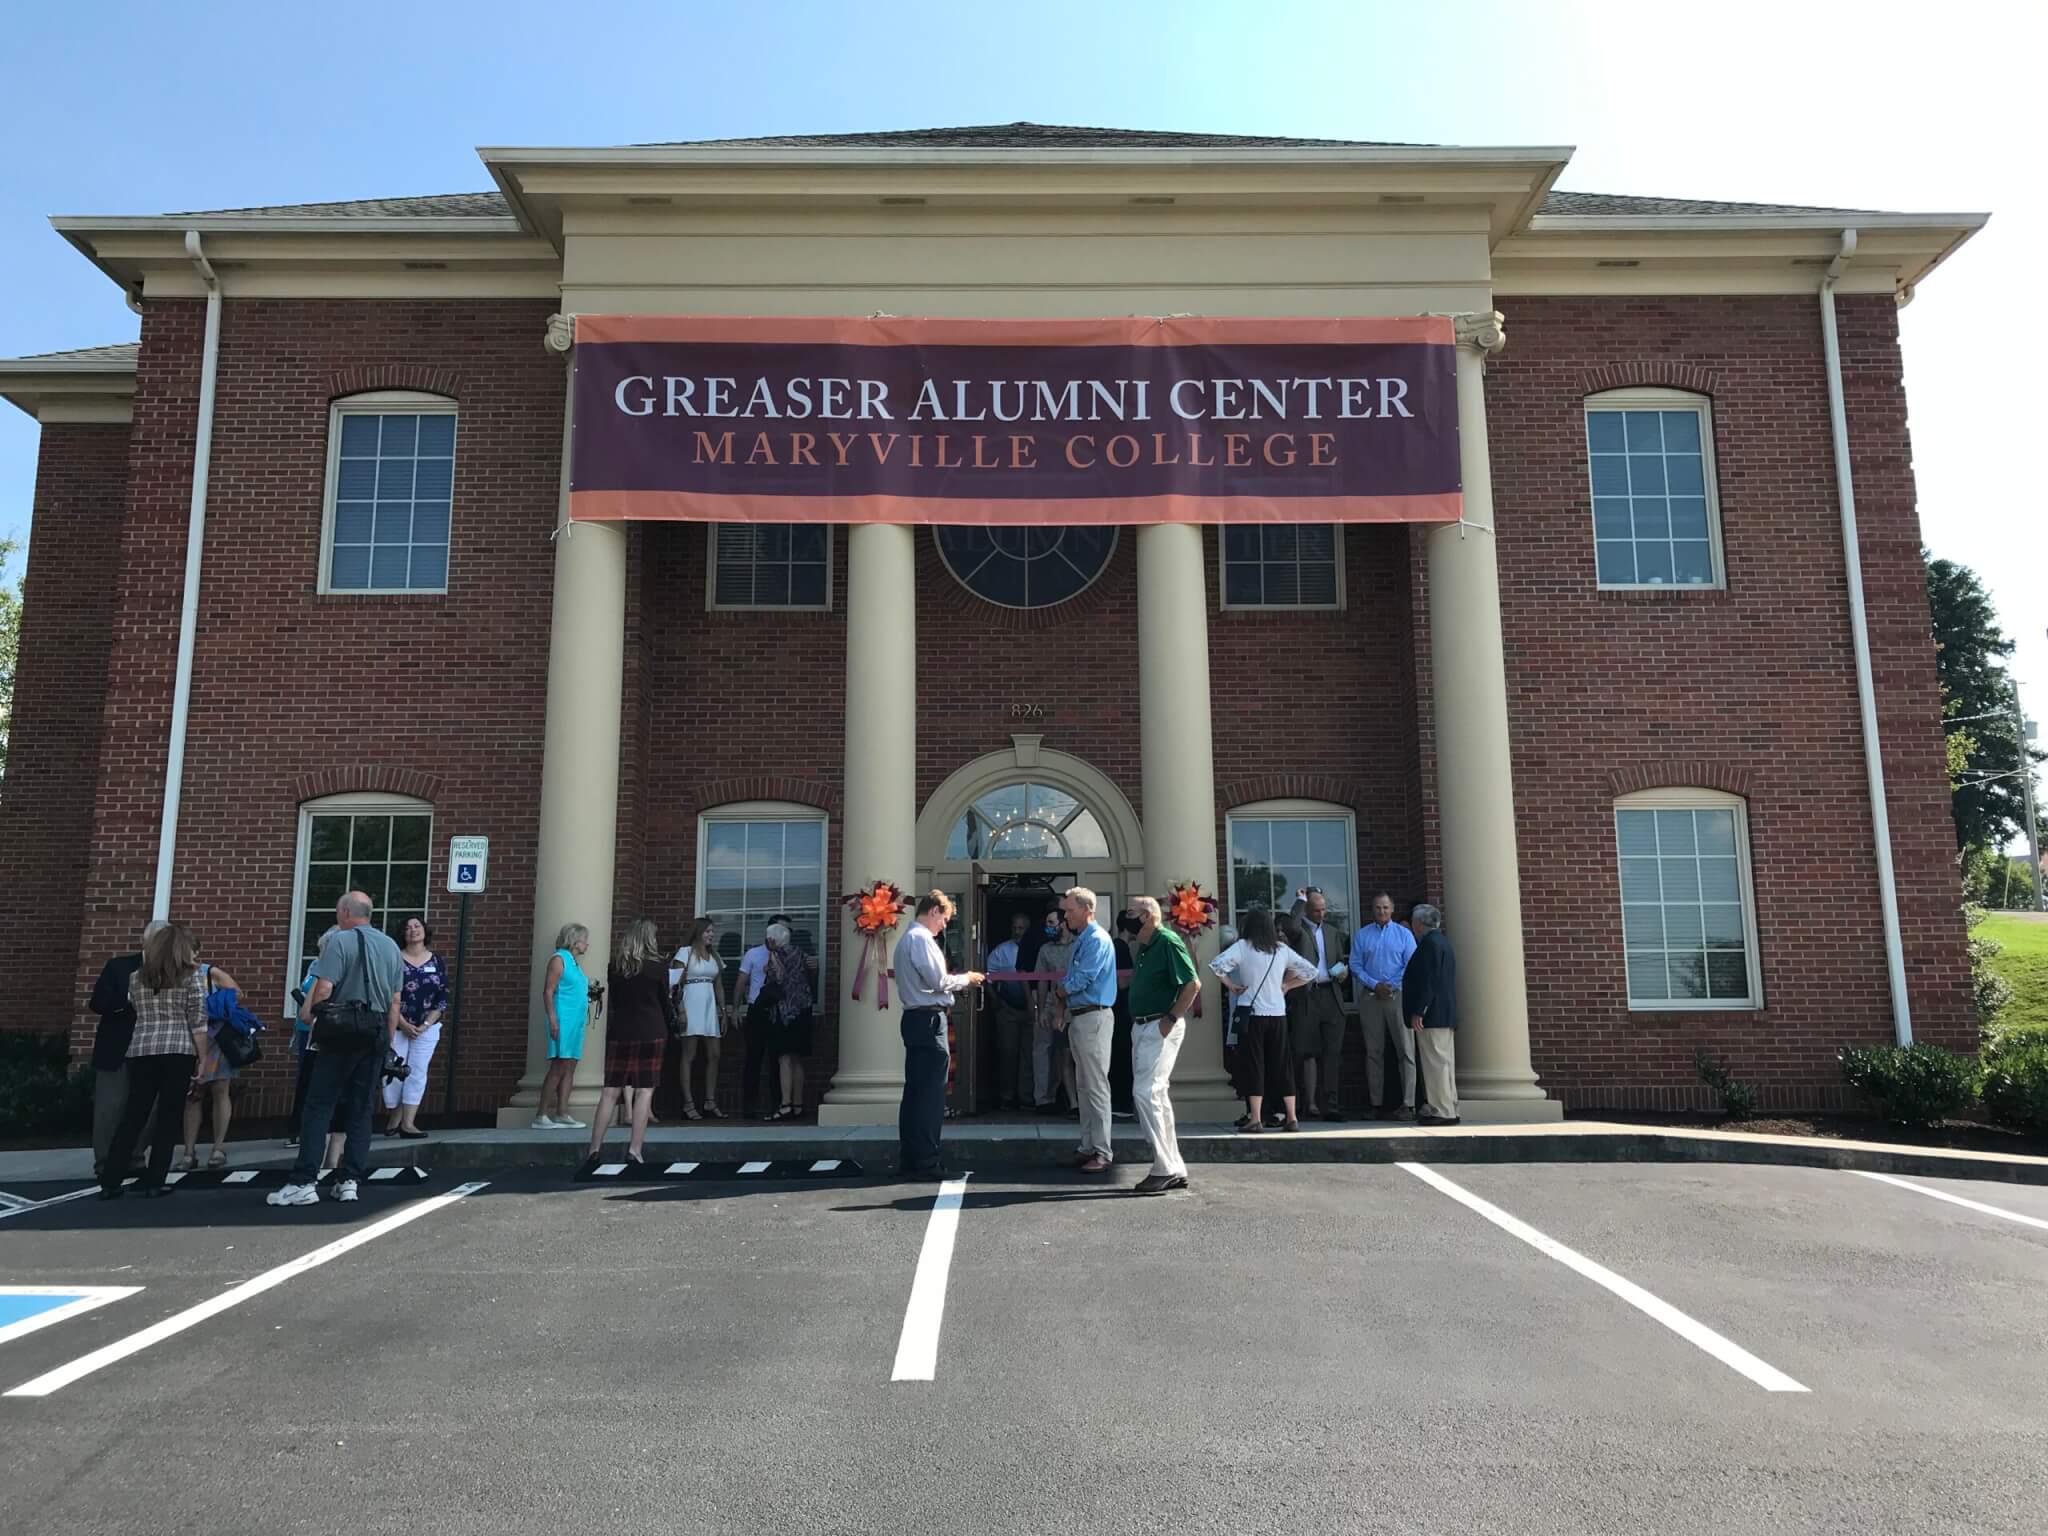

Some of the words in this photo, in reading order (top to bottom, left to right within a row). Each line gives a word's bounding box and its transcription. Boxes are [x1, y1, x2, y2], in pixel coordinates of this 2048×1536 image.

[614, 375, 895, 420] GREASER
[908, 378, 1152, 422] ALUMNI
[1169, 377, 1415, 420] CENTER
[691, 431, 1037, 468] MARYVILLE
[1064, 432, 1338, 468] COLLEGE
[1011, 703, 1043, 719] 826
[453, 841, 485, 850] RESERVED
[455, 850, 483, 858] PARKING
